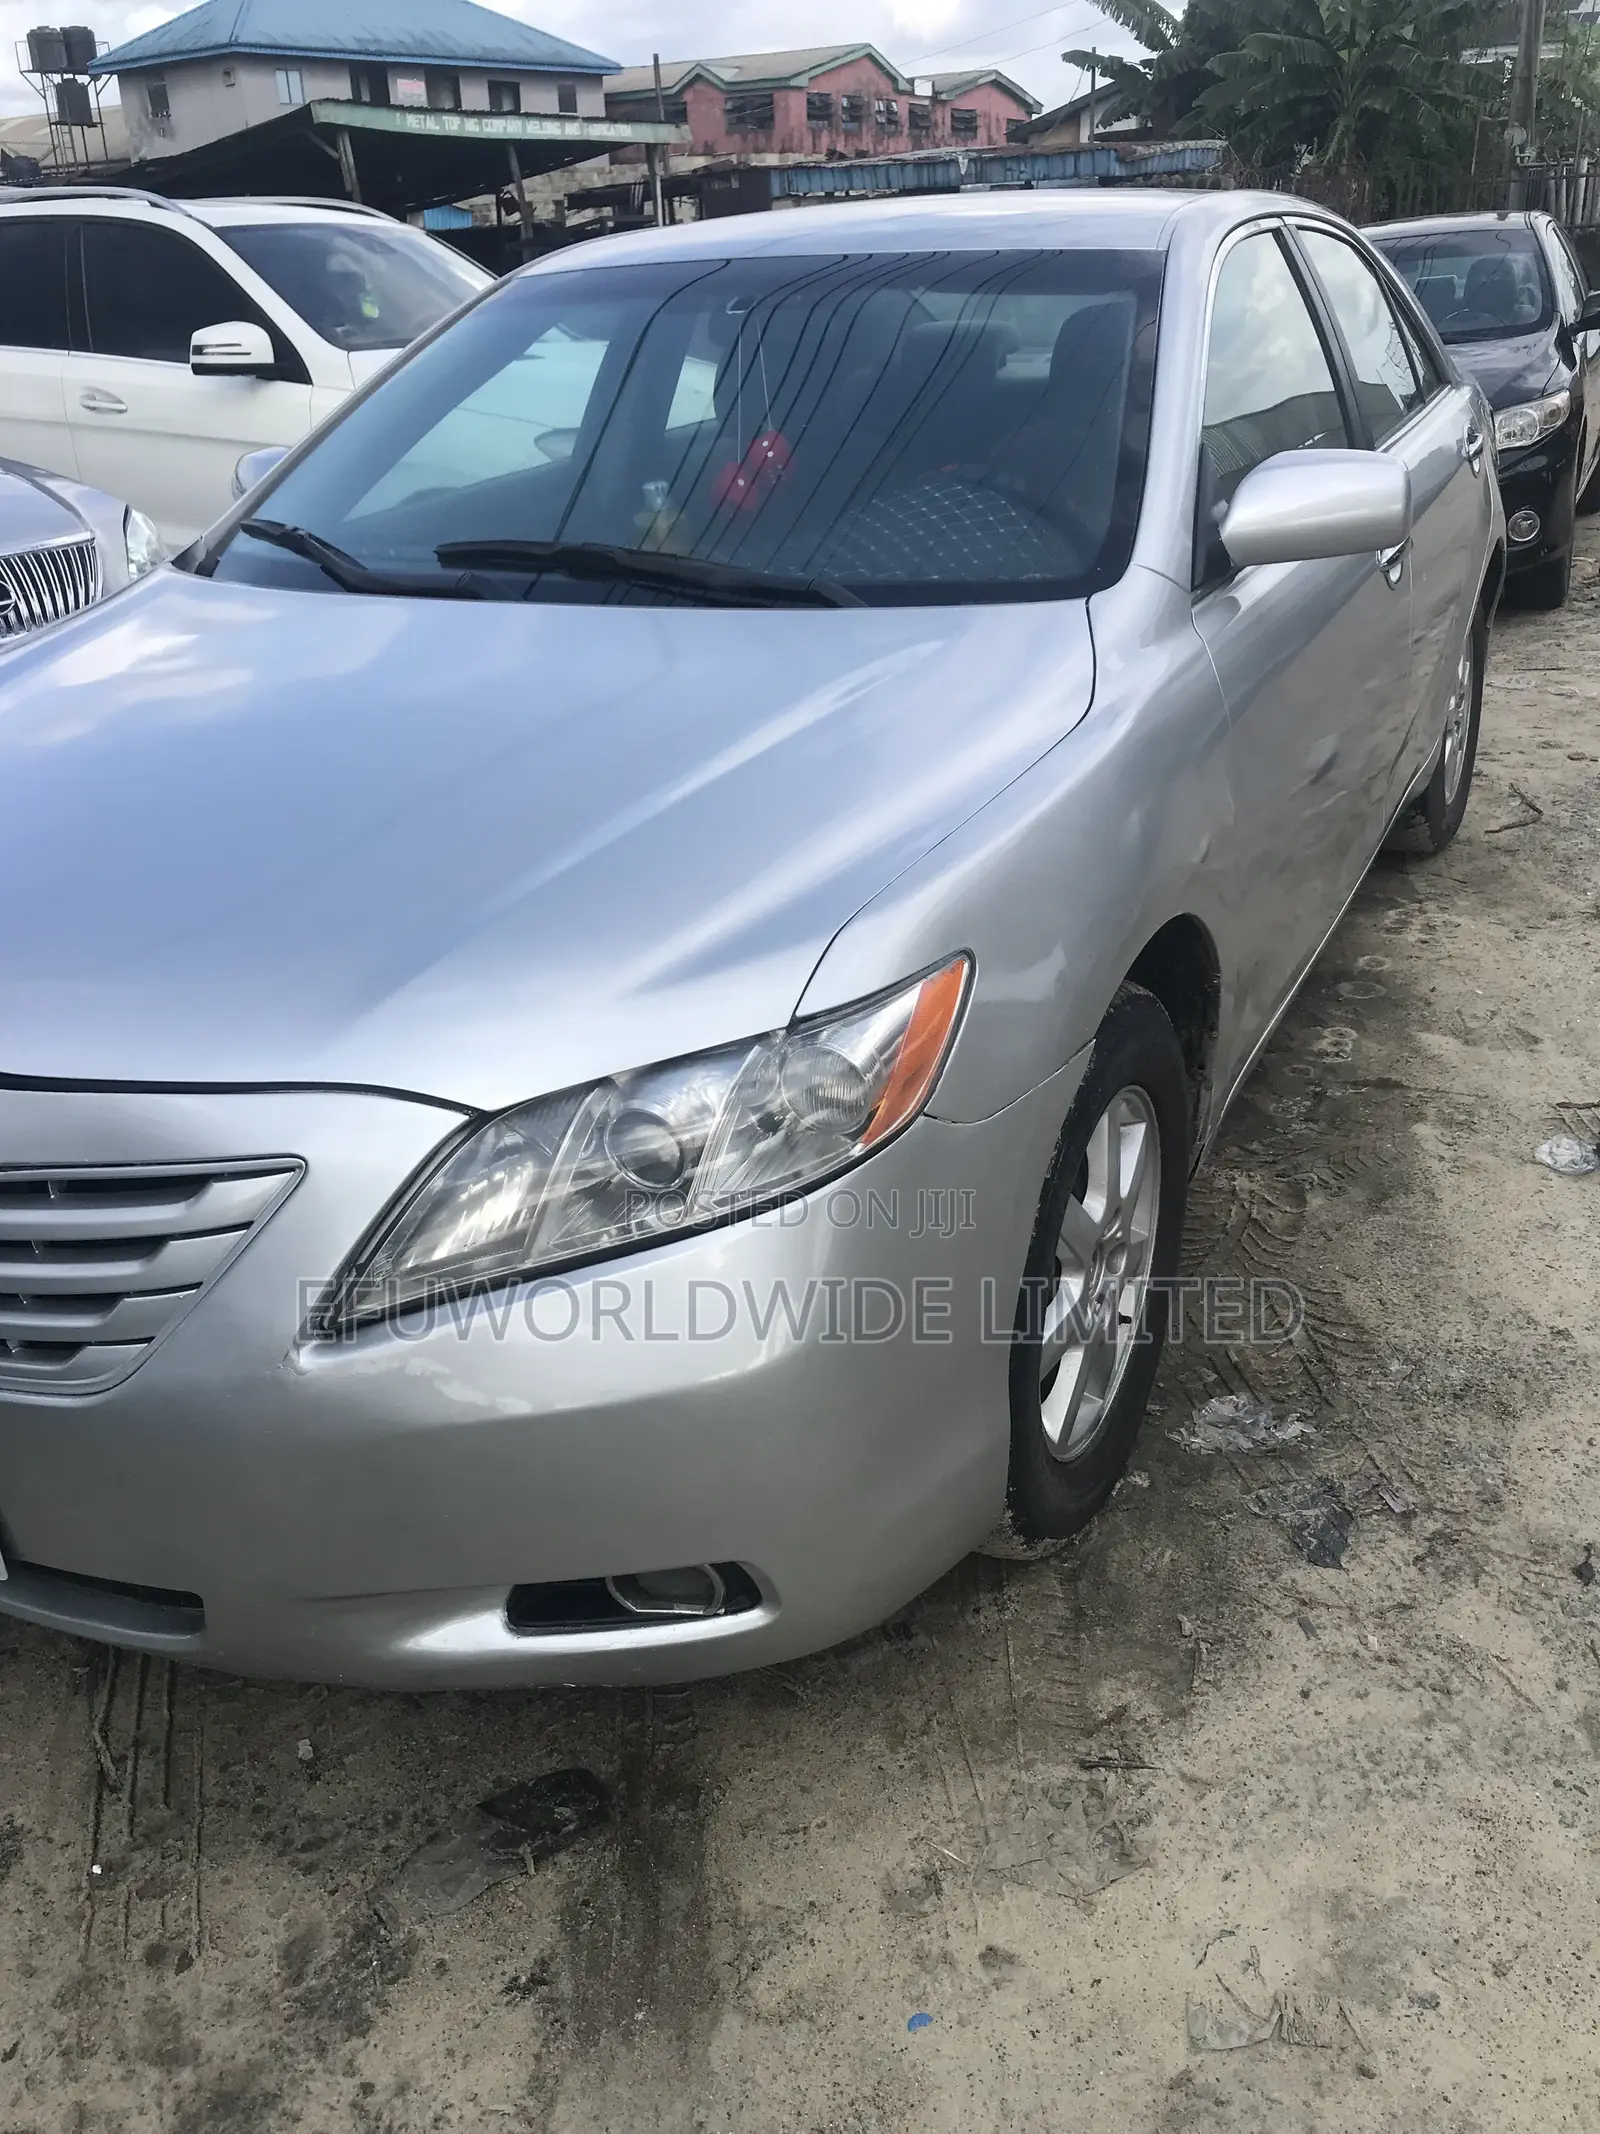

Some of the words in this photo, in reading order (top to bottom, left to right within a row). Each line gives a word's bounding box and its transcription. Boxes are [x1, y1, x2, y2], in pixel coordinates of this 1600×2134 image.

[405, 112, 440, 131] METAL
[442, 115, 461, 131] TOP
[482, 118, 523, 134] COMPANY
[525, 119, 561, 135] WELDING
